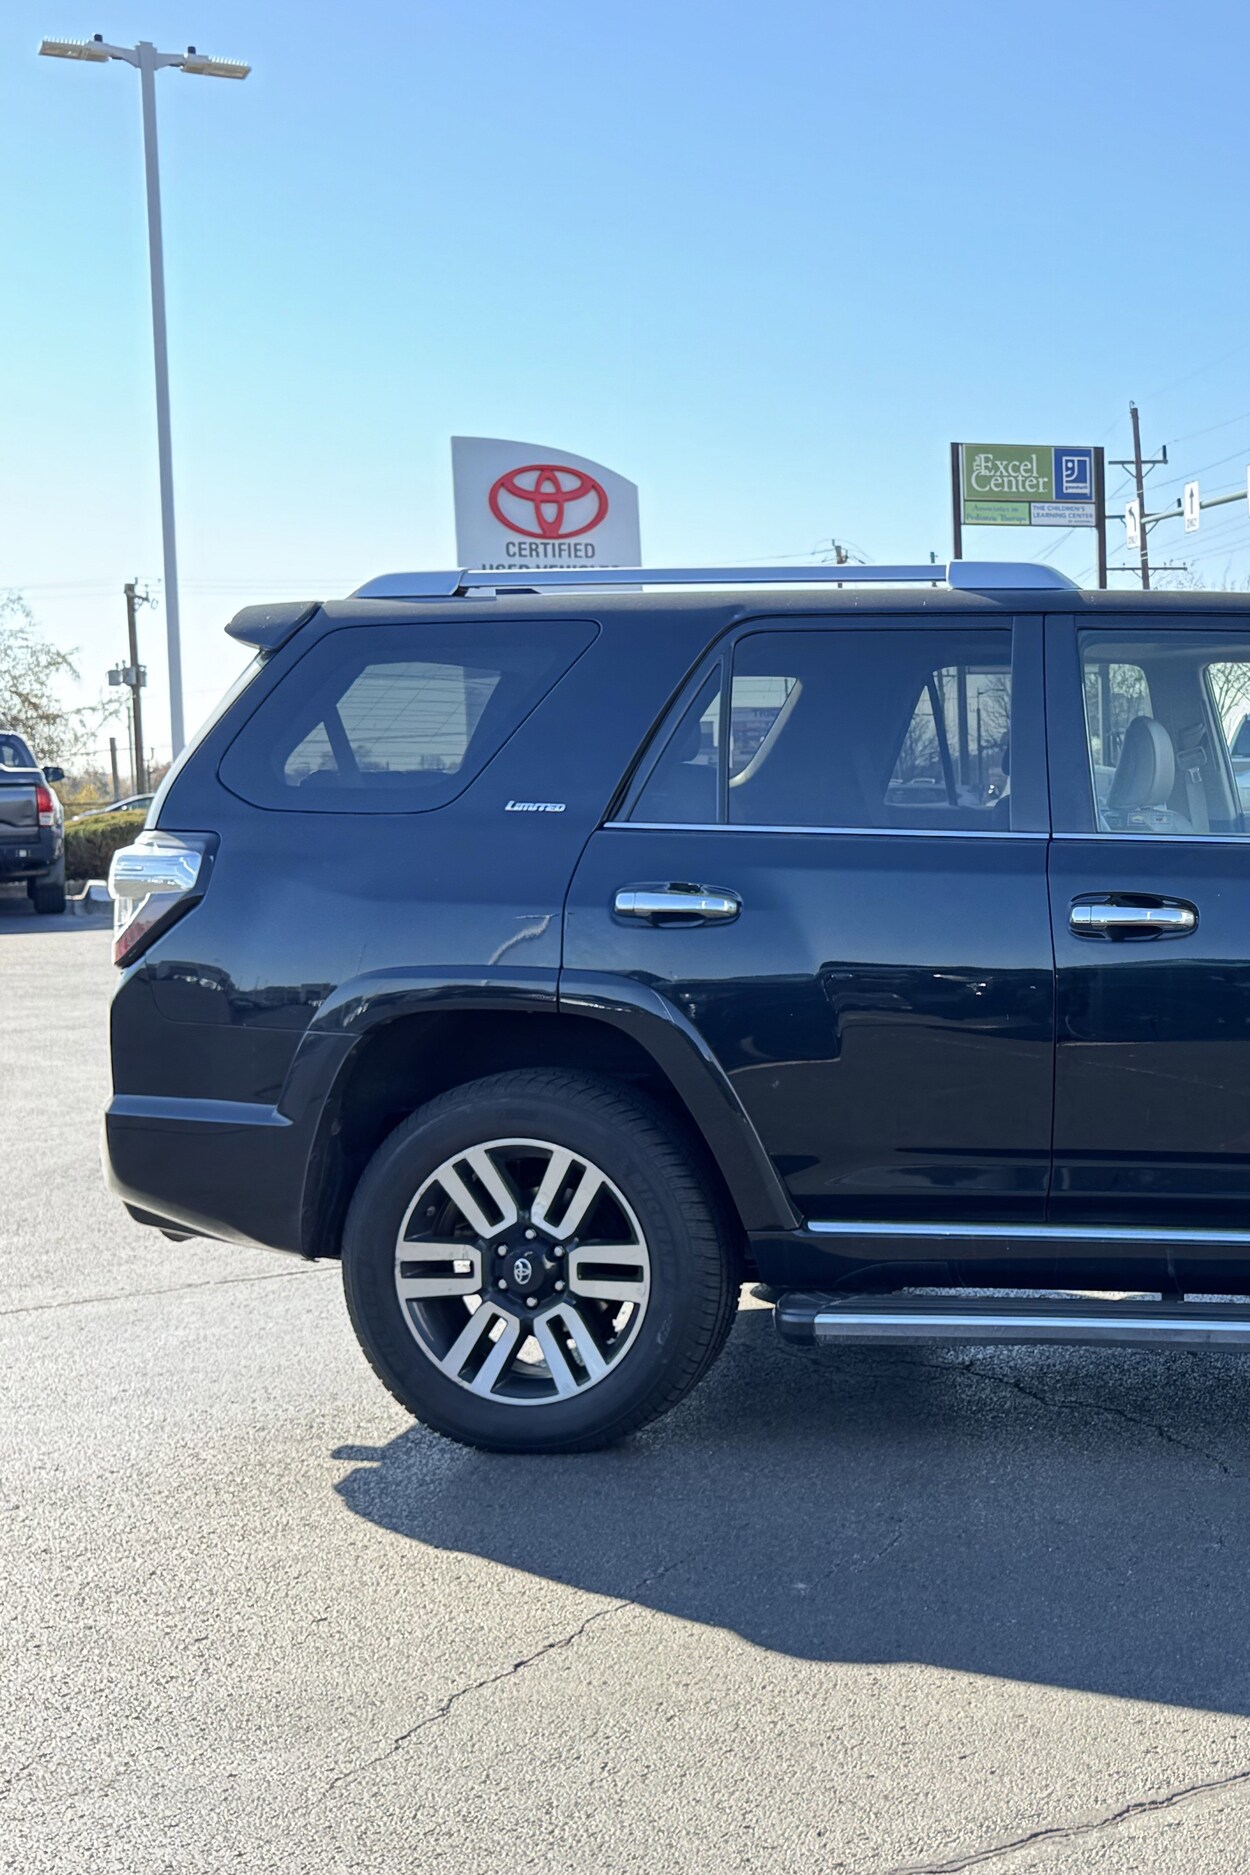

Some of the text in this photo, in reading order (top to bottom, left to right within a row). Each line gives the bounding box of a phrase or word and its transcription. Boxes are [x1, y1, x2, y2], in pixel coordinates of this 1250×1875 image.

[979, 453, 1039, 477] Excel
[971, 469, 1049, 493] Center
[505, 541, 596, 559] CERTIFIED
[504, 800, 567, 813] LIMITED
